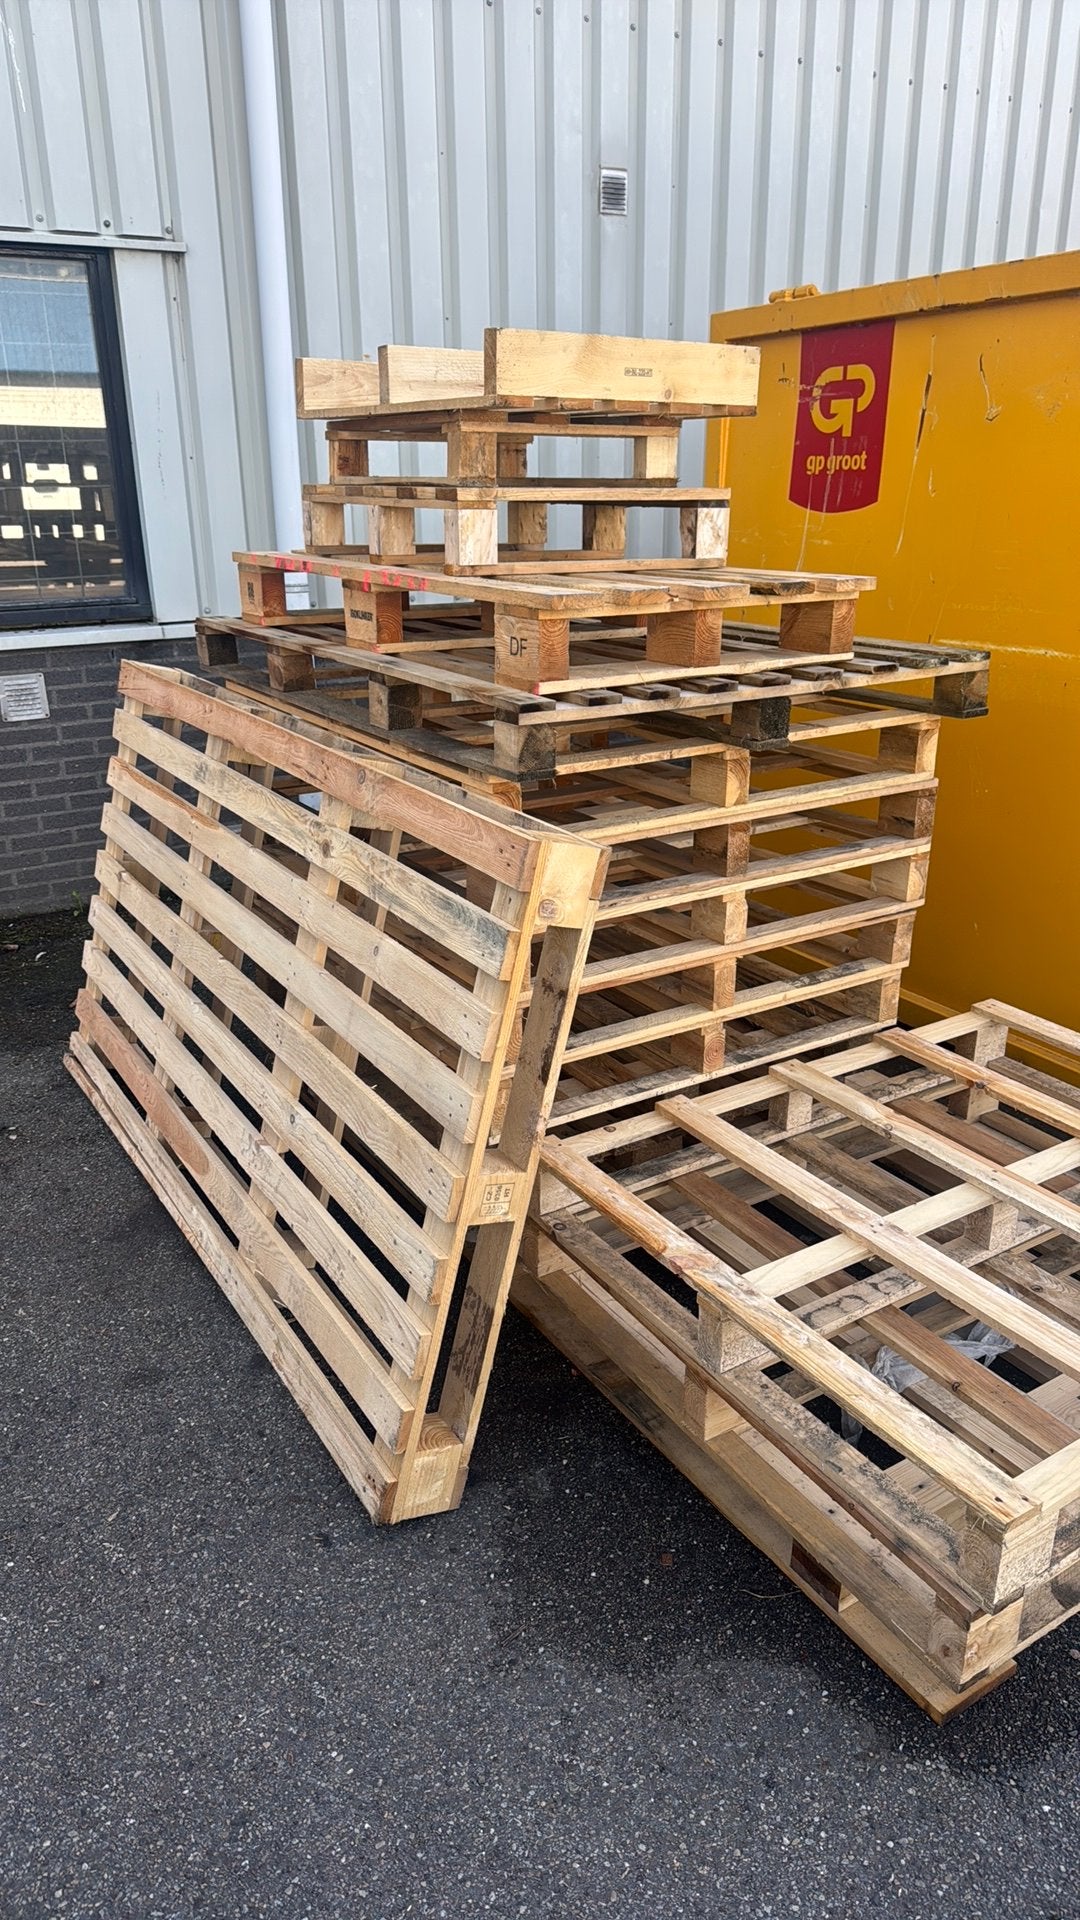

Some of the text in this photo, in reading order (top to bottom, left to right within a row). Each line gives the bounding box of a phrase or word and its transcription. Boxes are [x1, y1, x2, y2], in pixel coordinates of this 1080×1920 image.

[810, 364, 875, 437] GP
[806, 451, 867, 475] gp groot
[510, 636, 528, 657] DF
